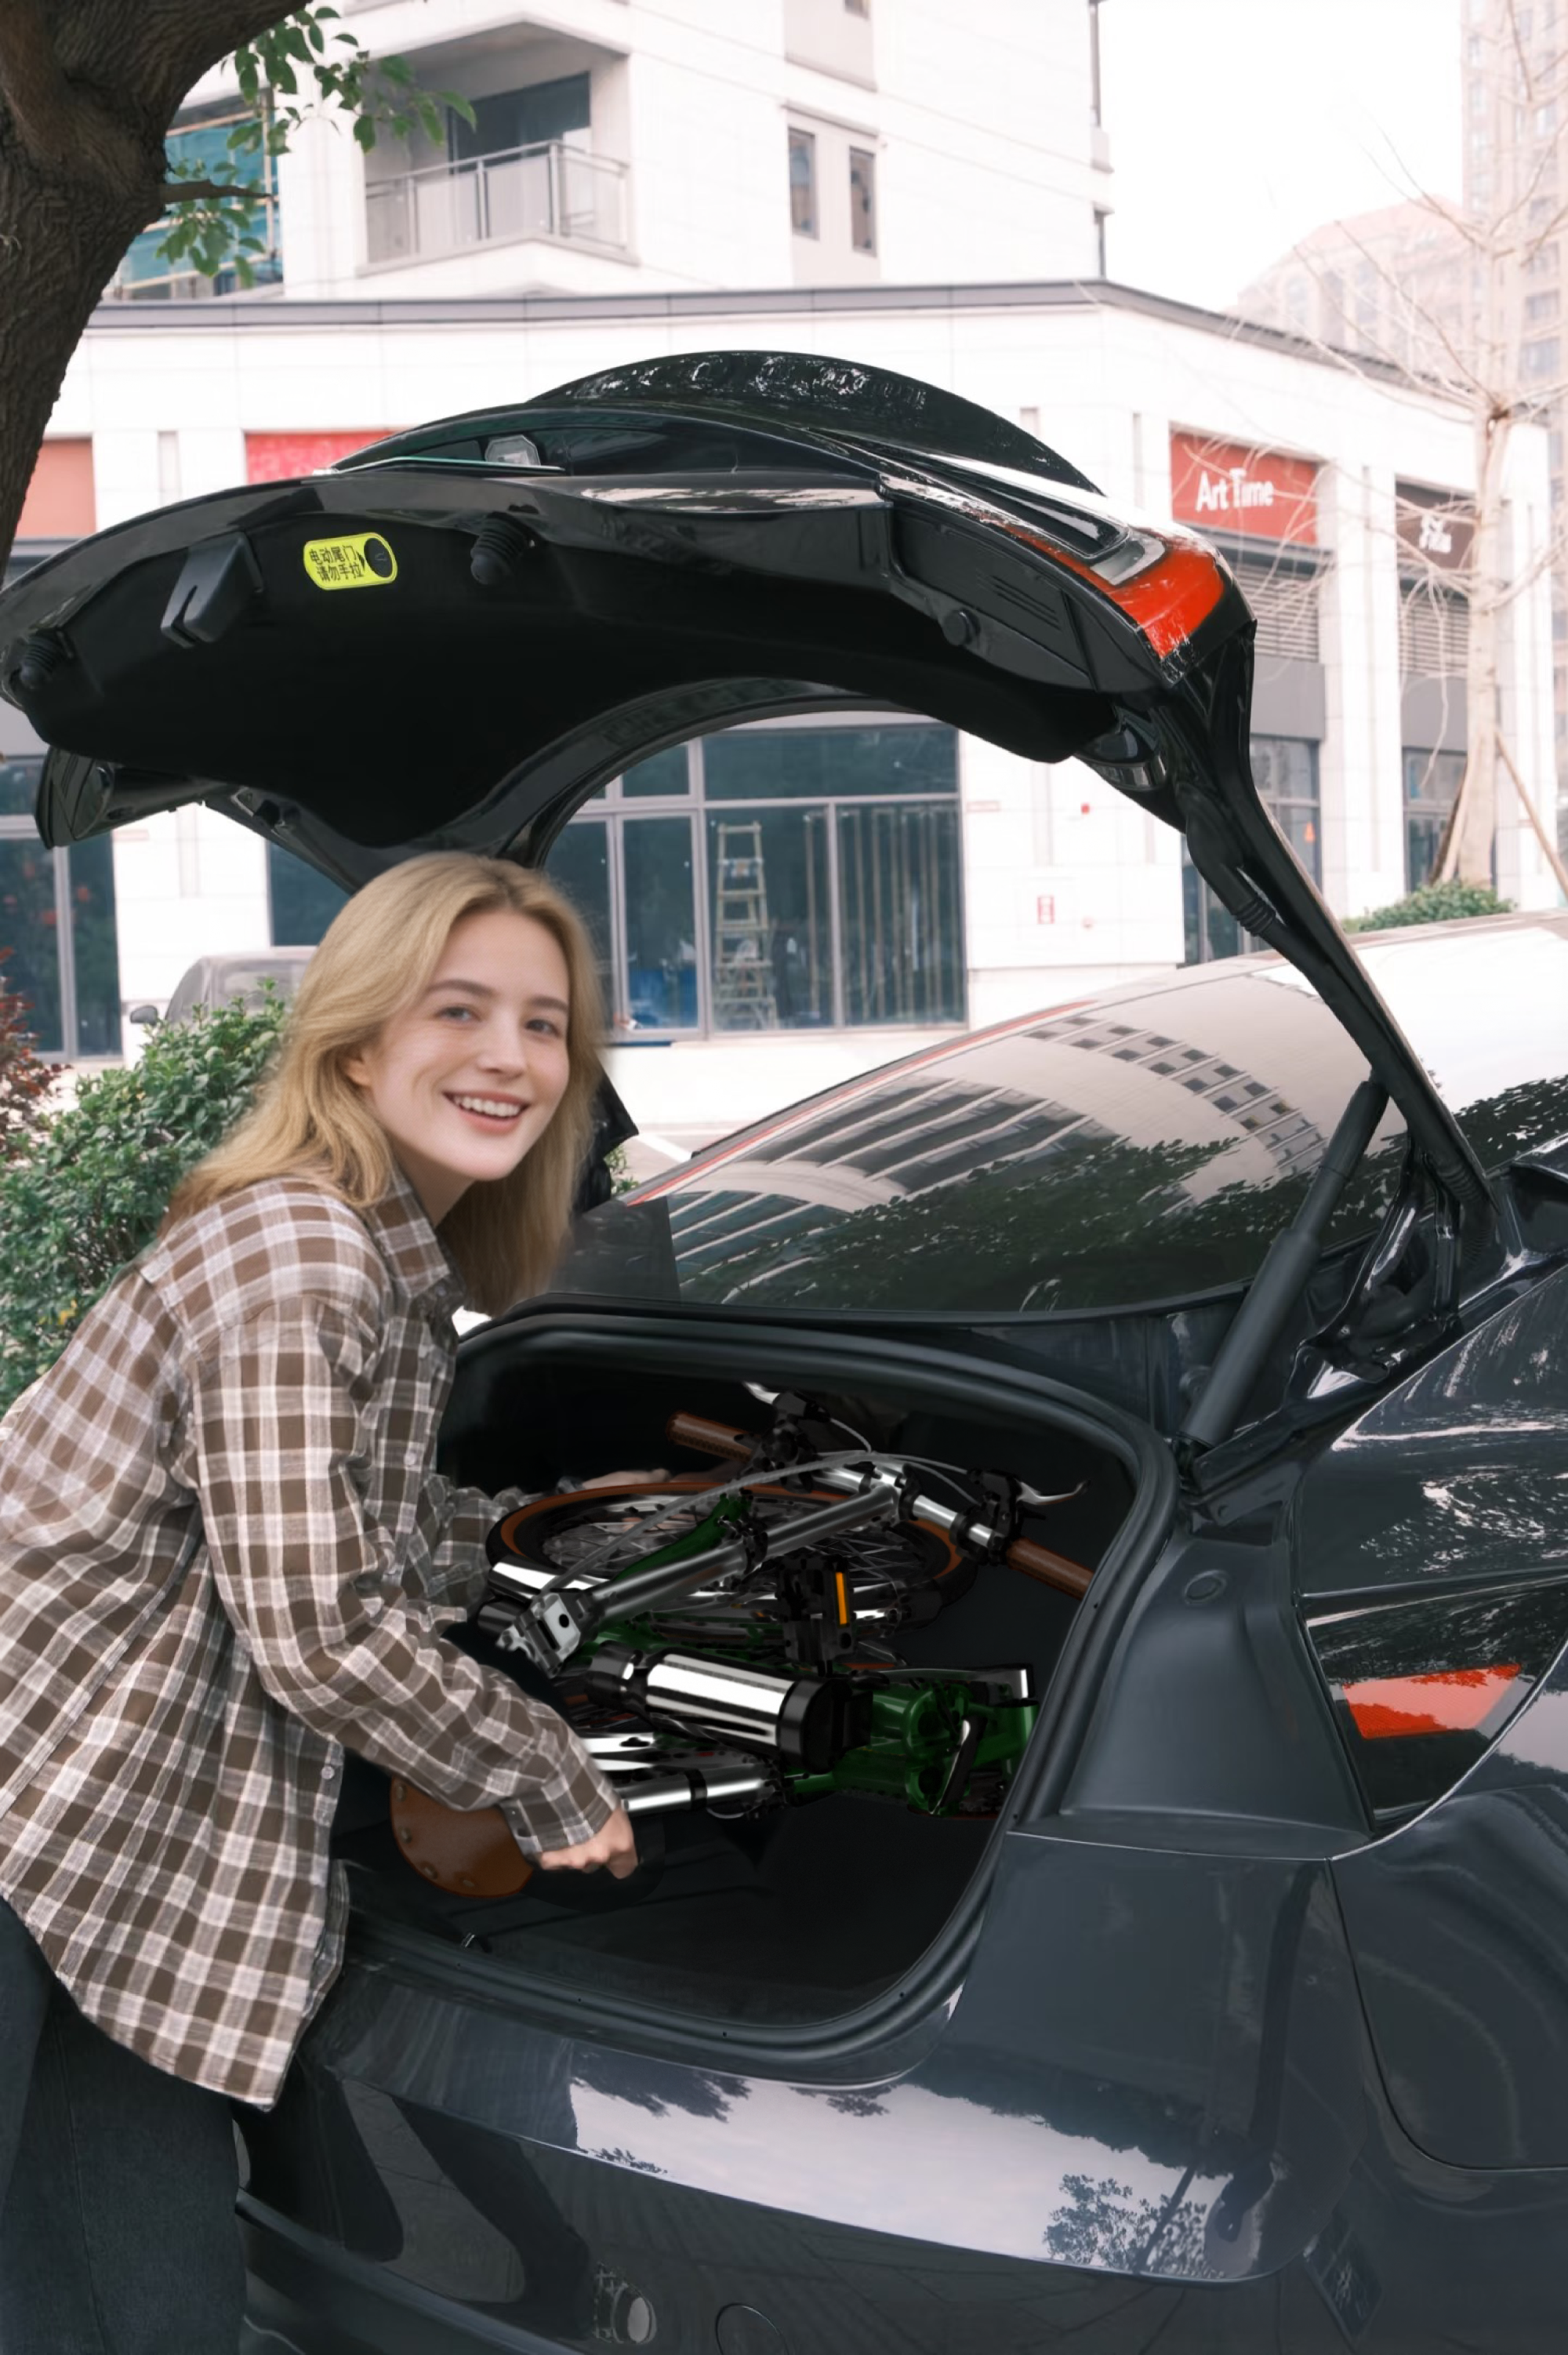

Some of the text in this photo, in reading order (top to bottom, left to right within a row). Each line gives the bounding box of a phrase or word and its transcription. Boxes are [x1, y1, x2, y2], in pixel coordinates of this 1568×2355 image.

[1196, 467, 1274, 512] Art Time
[309, 545, 357, 565] 电动尾门
[317, 562, 364, 581] 请勿手拉
